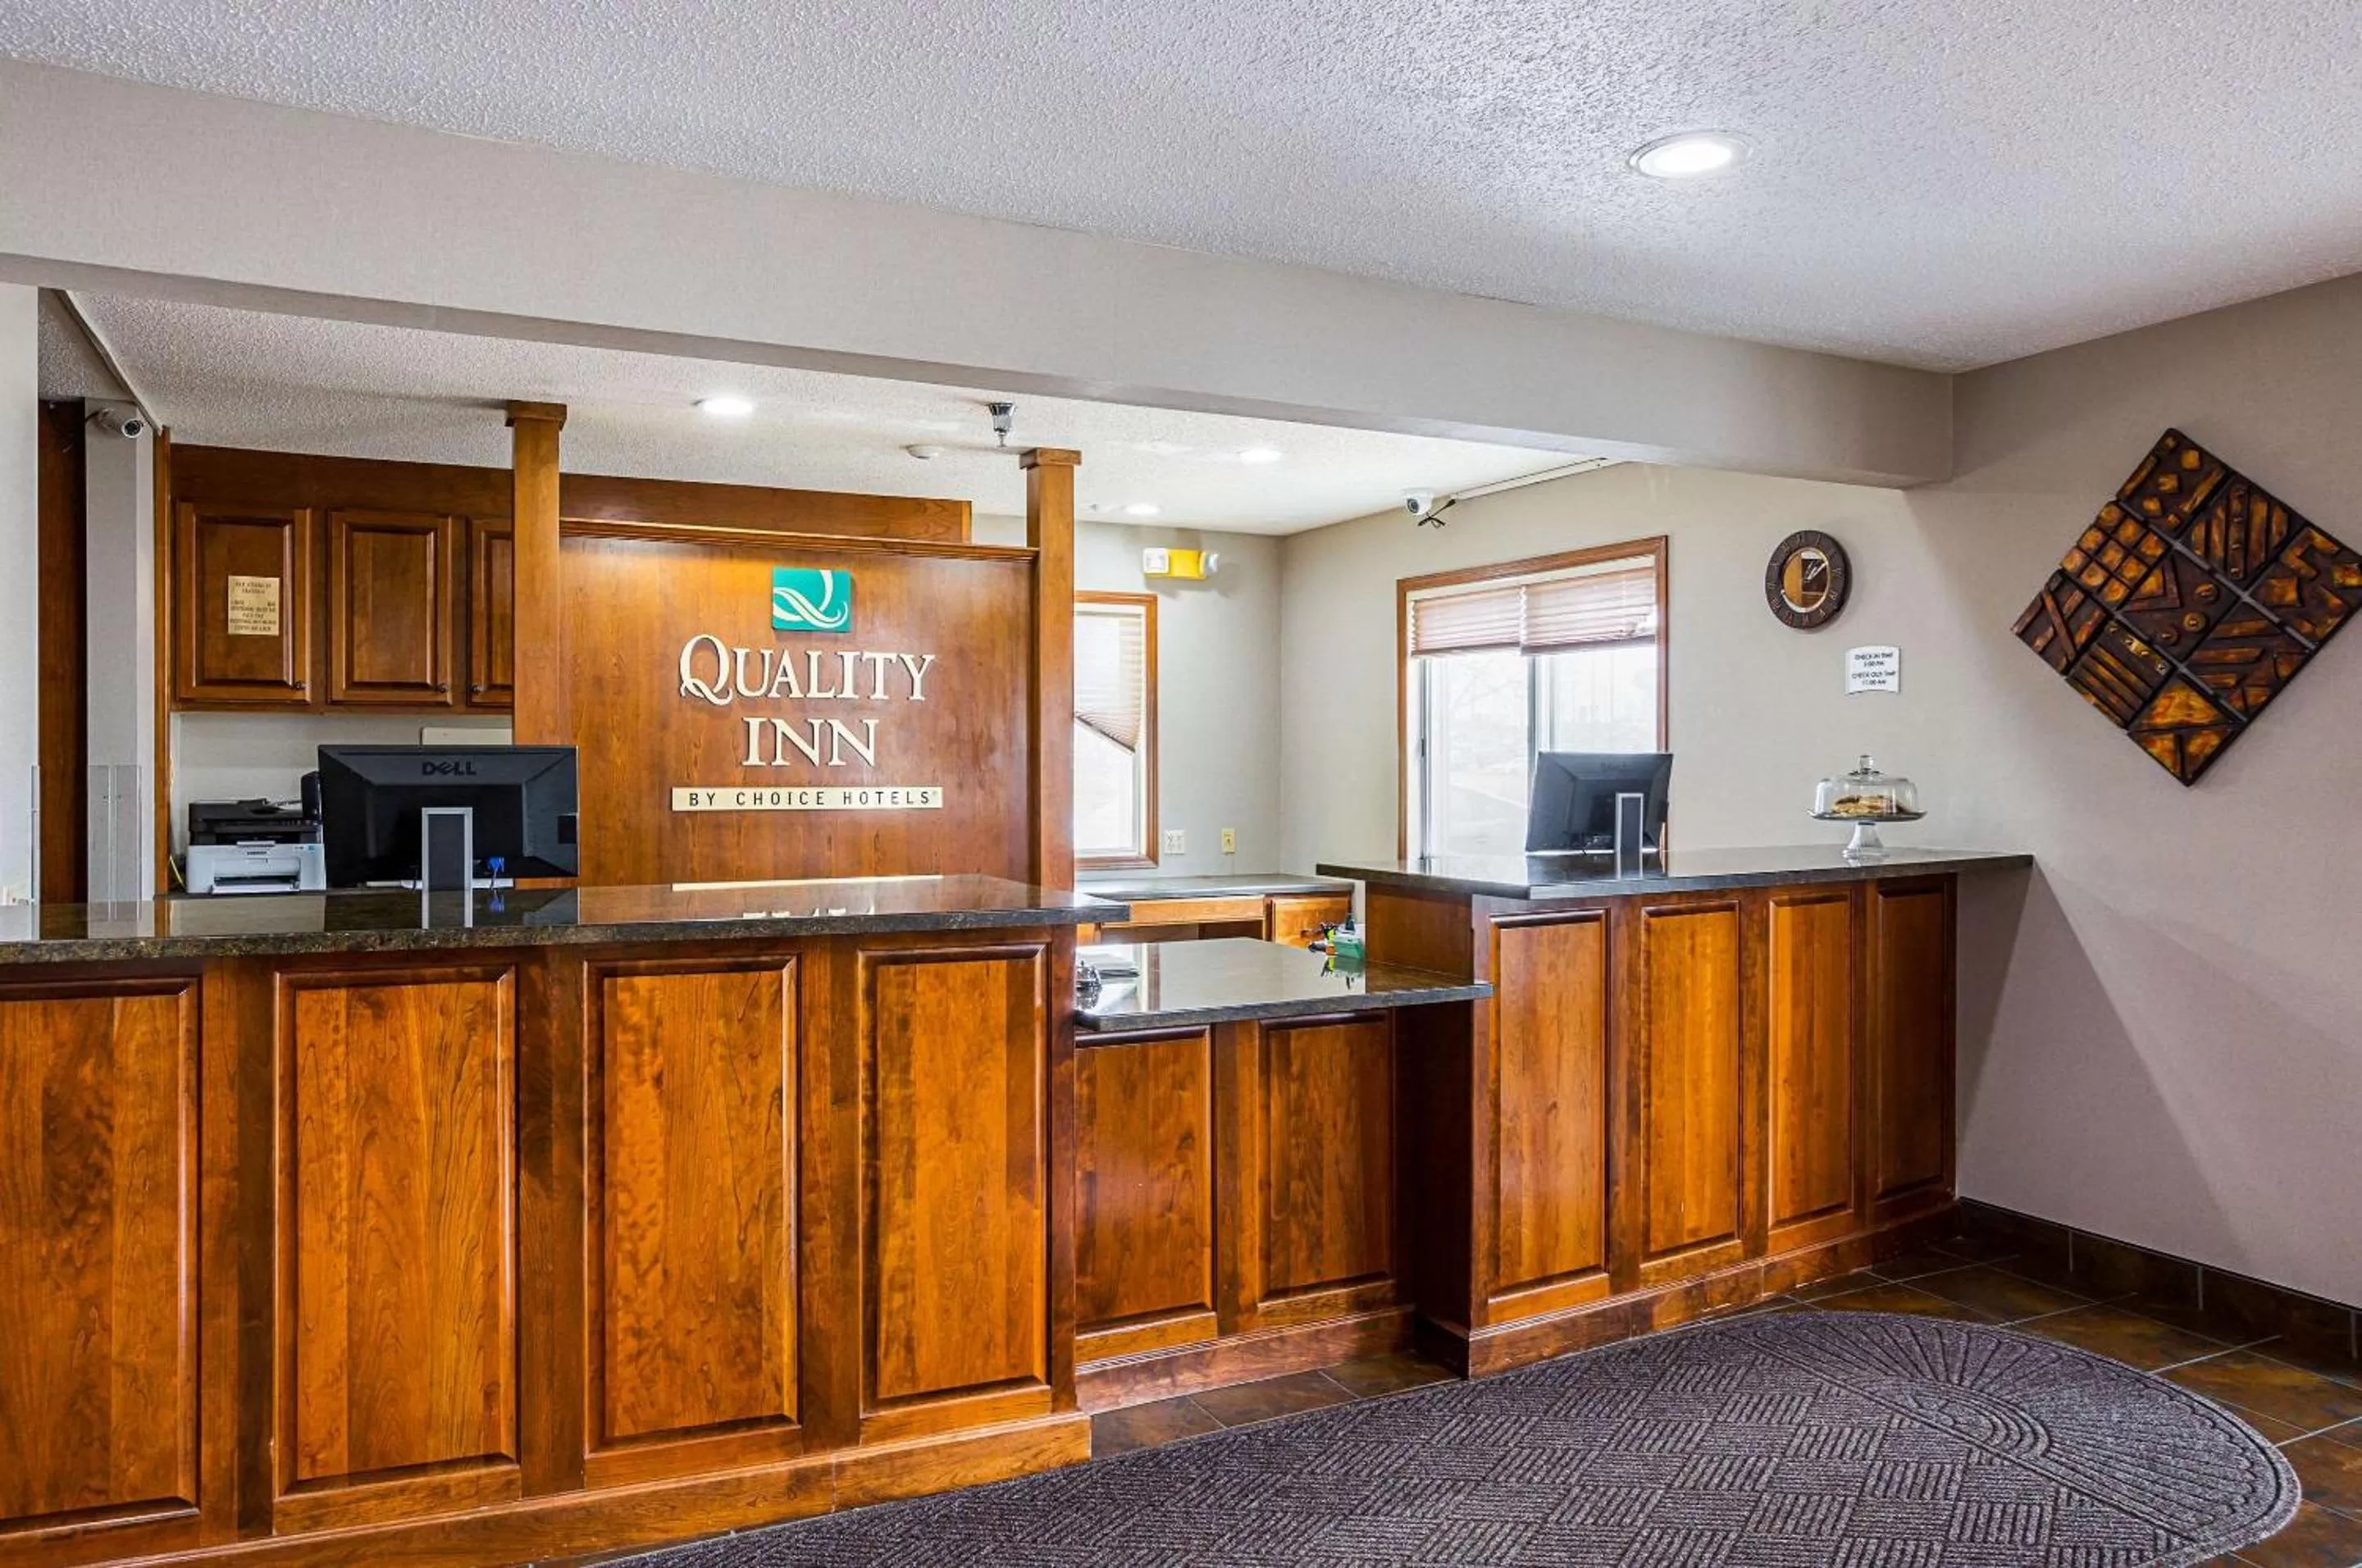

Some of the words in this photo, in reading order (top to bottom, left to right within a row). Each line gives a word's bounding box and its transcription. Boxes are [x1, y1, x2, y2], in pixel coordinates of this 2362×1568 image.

[679, 634, 935, 705] QUALITY
[741, 717, 879, 767] INN
[422, 761, 477, 776] DELL
[689, 792, 715, 806] BY
[736, 791, 824, 805] CHOICE
[843, 791, 931, 805] HOTELS
